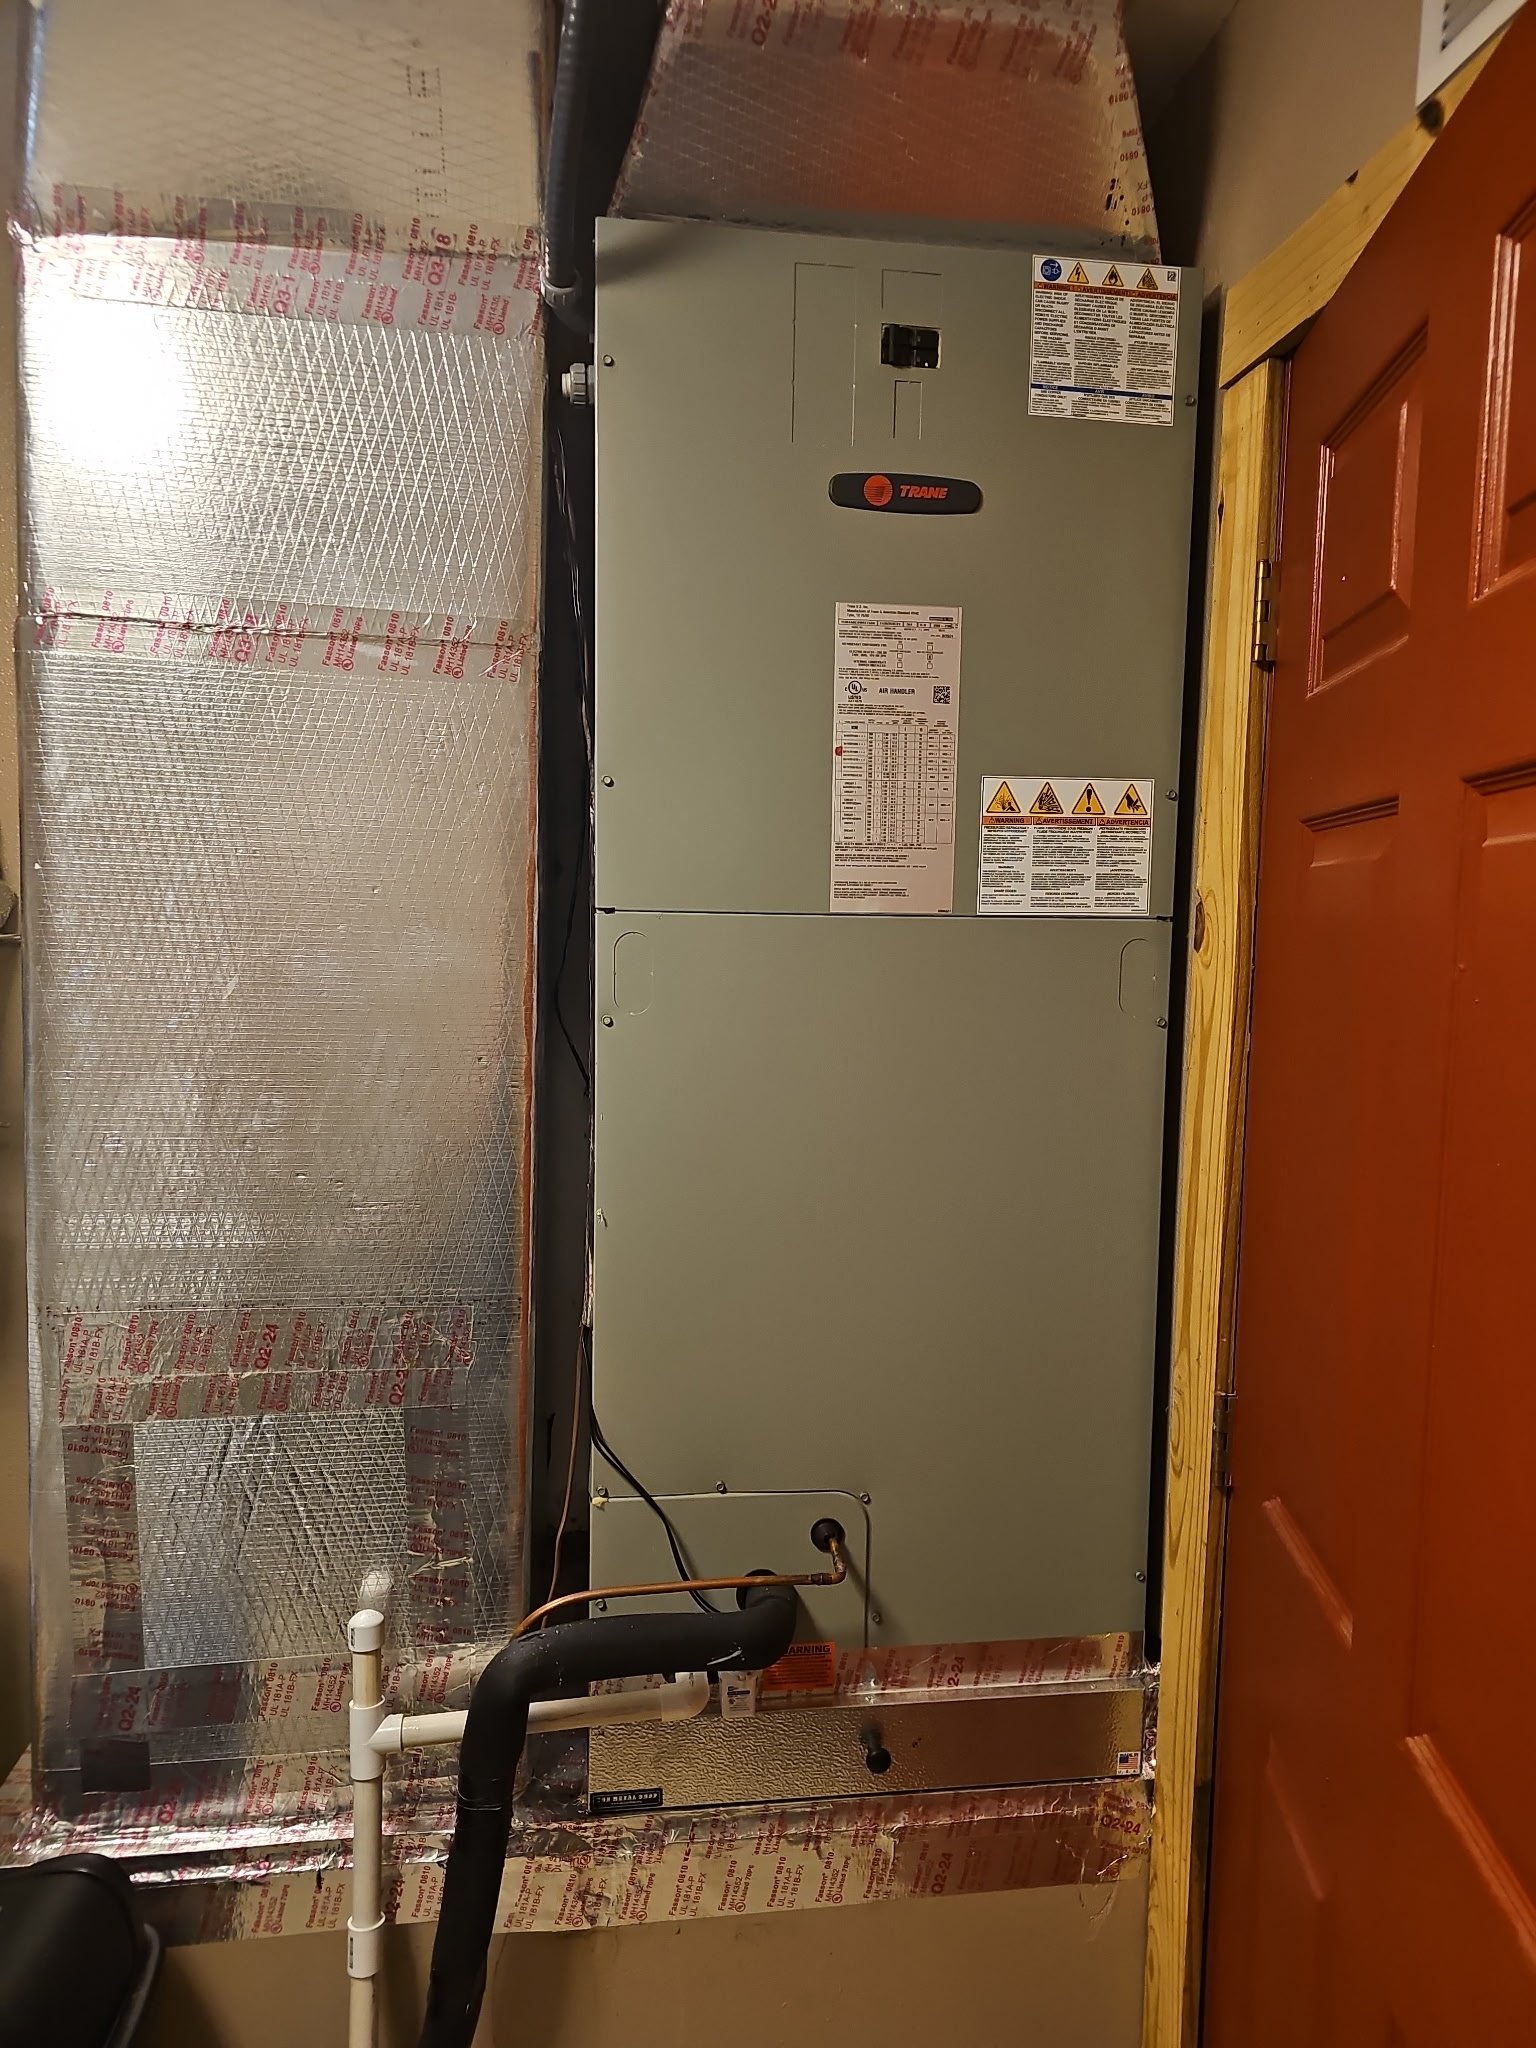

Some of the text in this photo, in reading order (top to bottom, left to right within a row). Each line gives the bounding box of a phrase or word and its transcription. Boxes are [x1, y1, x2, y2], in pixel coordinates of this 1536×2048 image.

[467, 224, 479, 246] 0810
[470, 275, 480, 287] UL
[481, 279, 491, 291] UL
[316, 305, 327, 316] UL
[329, 309, 337, 320] UL
[429, 315, 440, 327] UL
[441, 318, 451, 330] UL
[900, 485, 948, 499] TRANE
[387, 612, 399, 634] 0810
[443, 615, 454, 637] 0810
[497, 620, 509, 643] 0810
[278, 650, 288, 664] UL
[289, 655, 298, 668] UL
[389, 662, 398, 672] UL
[401, 664, 411, 676] UL
[498, 667, 507, 679] UL
[509, 672, 517, 683] UL
[254, 1323, 279, 1369] Q2-24
[73, 1362, 83, 1373] UL
[85, 1365, 95, 1376] UL
[185, 1359, 195, 1370] UL
[112, 1409, 122, 1421] UL
[425, 1649, 436, 1668] 0810
[789, 1645, 831, 1653] ARNING
[267, 1662, 278, 1682] 0810
[321, 1657, 331, 1677] 0810
[948, 1656, 966, 1687] 2-24
[280, 1670, 298, 1717] UL 181B-FX
[322, 1675, 337, 1710] MH14352
[119, 1686, 142, 1731] Q2-24
[270, 1705, 279, 1716] UL
[385, 1698, 395, 1708] UL
[307, 1756, 318, 1776] 0810
[1101, 1814, 1141, 1835] Q2-24
[767, 1856, 787, 1908] Fasson 0810
[815, 1851, 835, 1903] Fasson 0810
[836, 1873, 847, 1893] Listed
[931, 1852, 953, 1894] Q2-24
[411, 1866, 431, 1918] Fasson 0810
[618, 1867, 638, 1920] Fasson 0810
[669, 1865, 688, 1916] Fasson 0810
[679, 1875, 694, 1915] UL 181A-P
[689, 1872, 707, 1916] UL 181B-FX
[718, 1860, 738, 1911] Fasson 0810
[728, 1876, 743, 1911] MH14352
[777, 1867, 792, 1907] UL 181A-P
[787, 1864, 805, 1908] UL 181B-FX
[825, 1869, 840, 1902] MH14352
[423, 1876, 438, 1917] UL 181A-P
[555, 1874, 577, 1925] Fasson 0810
[515, 1918, 524, 1928] UL
[520, 1888, 532, 1915] 181A-P
[525, 1885, 545, 1930] UL 181B-FX
[317, 1916, 326, 1927] UL
[328, 1918, 337, 1928] UL
